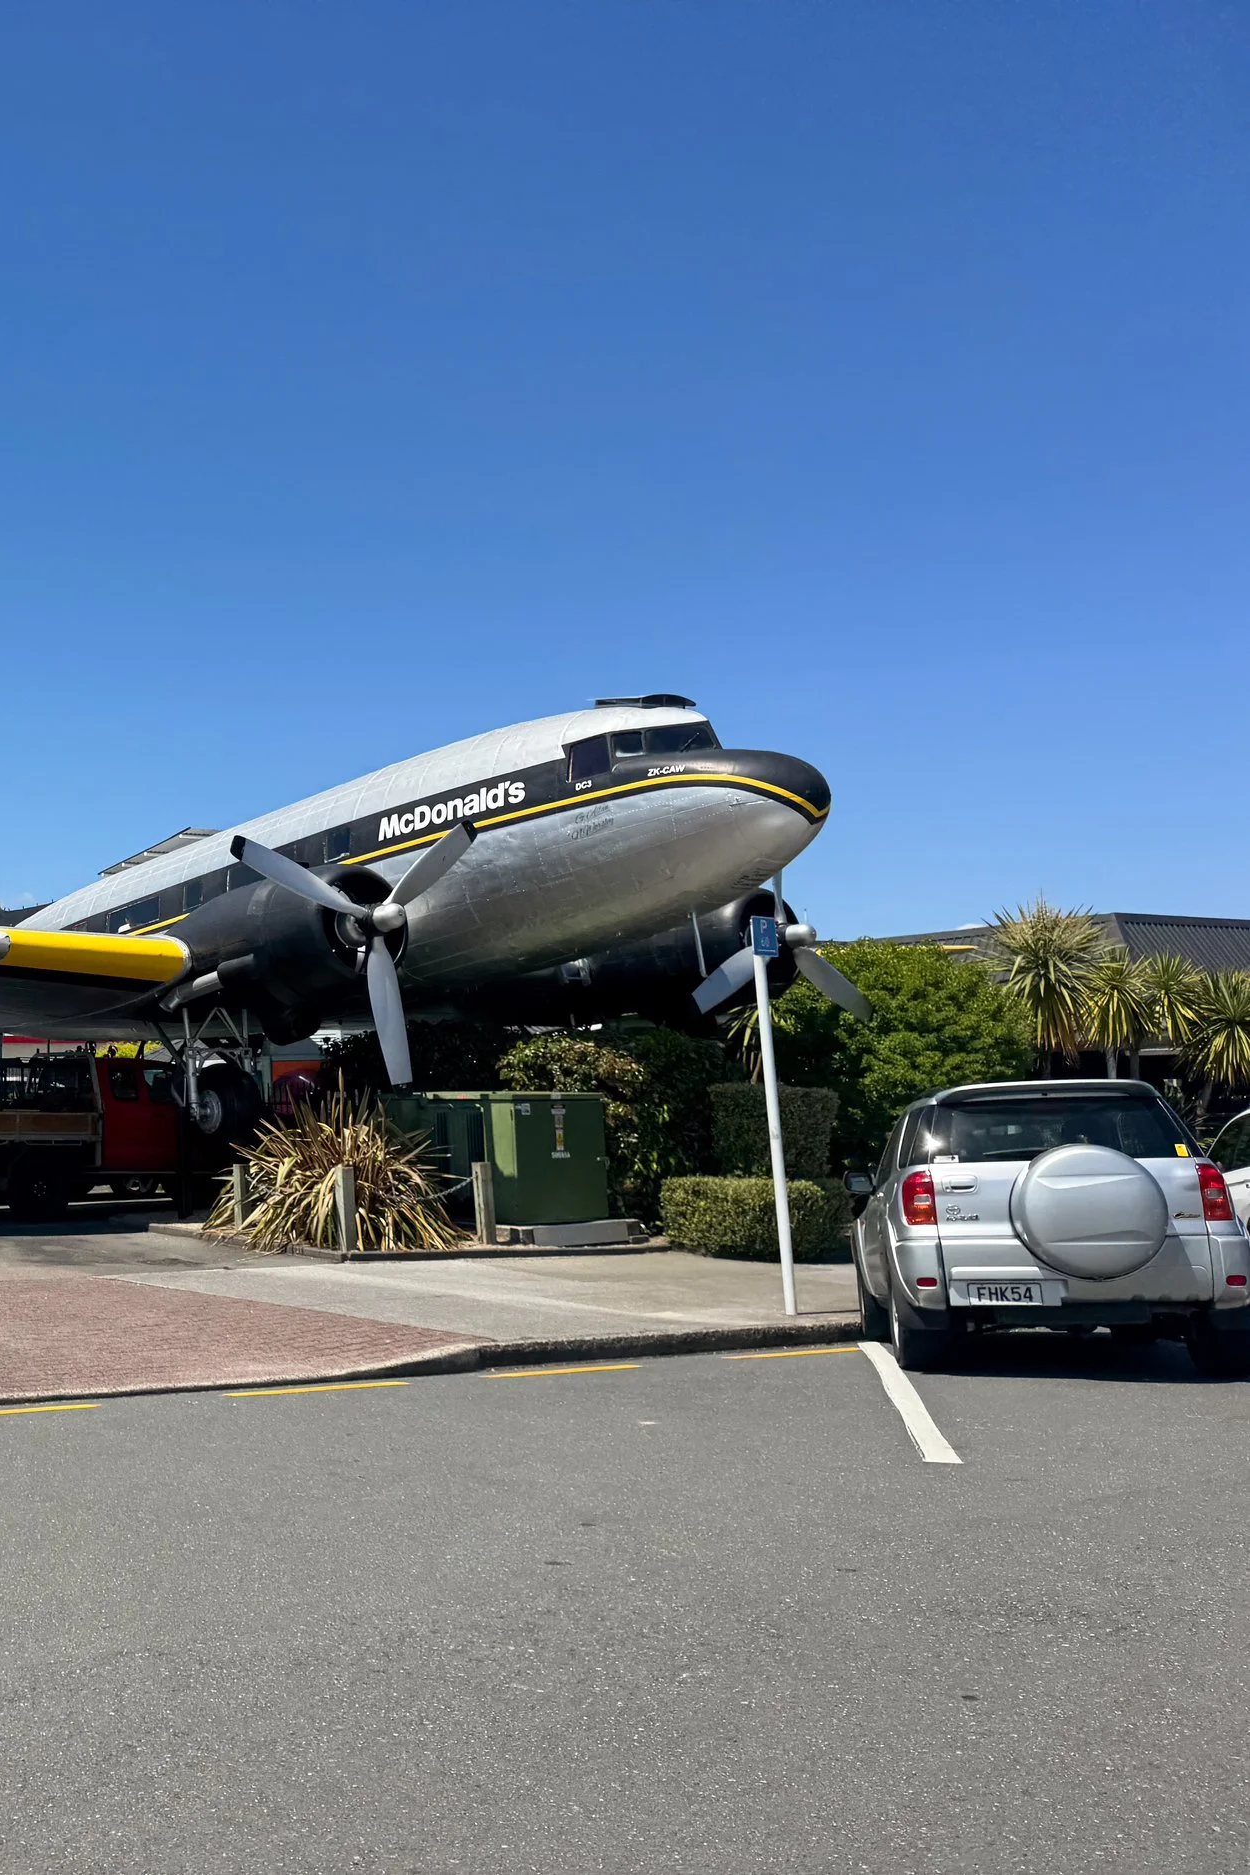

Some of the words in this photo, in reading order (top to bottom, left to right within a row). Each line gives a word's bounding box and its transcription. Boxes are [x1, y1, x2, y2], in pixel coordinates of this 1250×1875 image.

[647, 764, 686, 777] ZK-CAW
[575, 780, 592, 791] DC3
[378, 781, 526, 842] McDonald's
[760, 919, 768, 934] P
[977, 1286, 1034, 1302] FHK54
